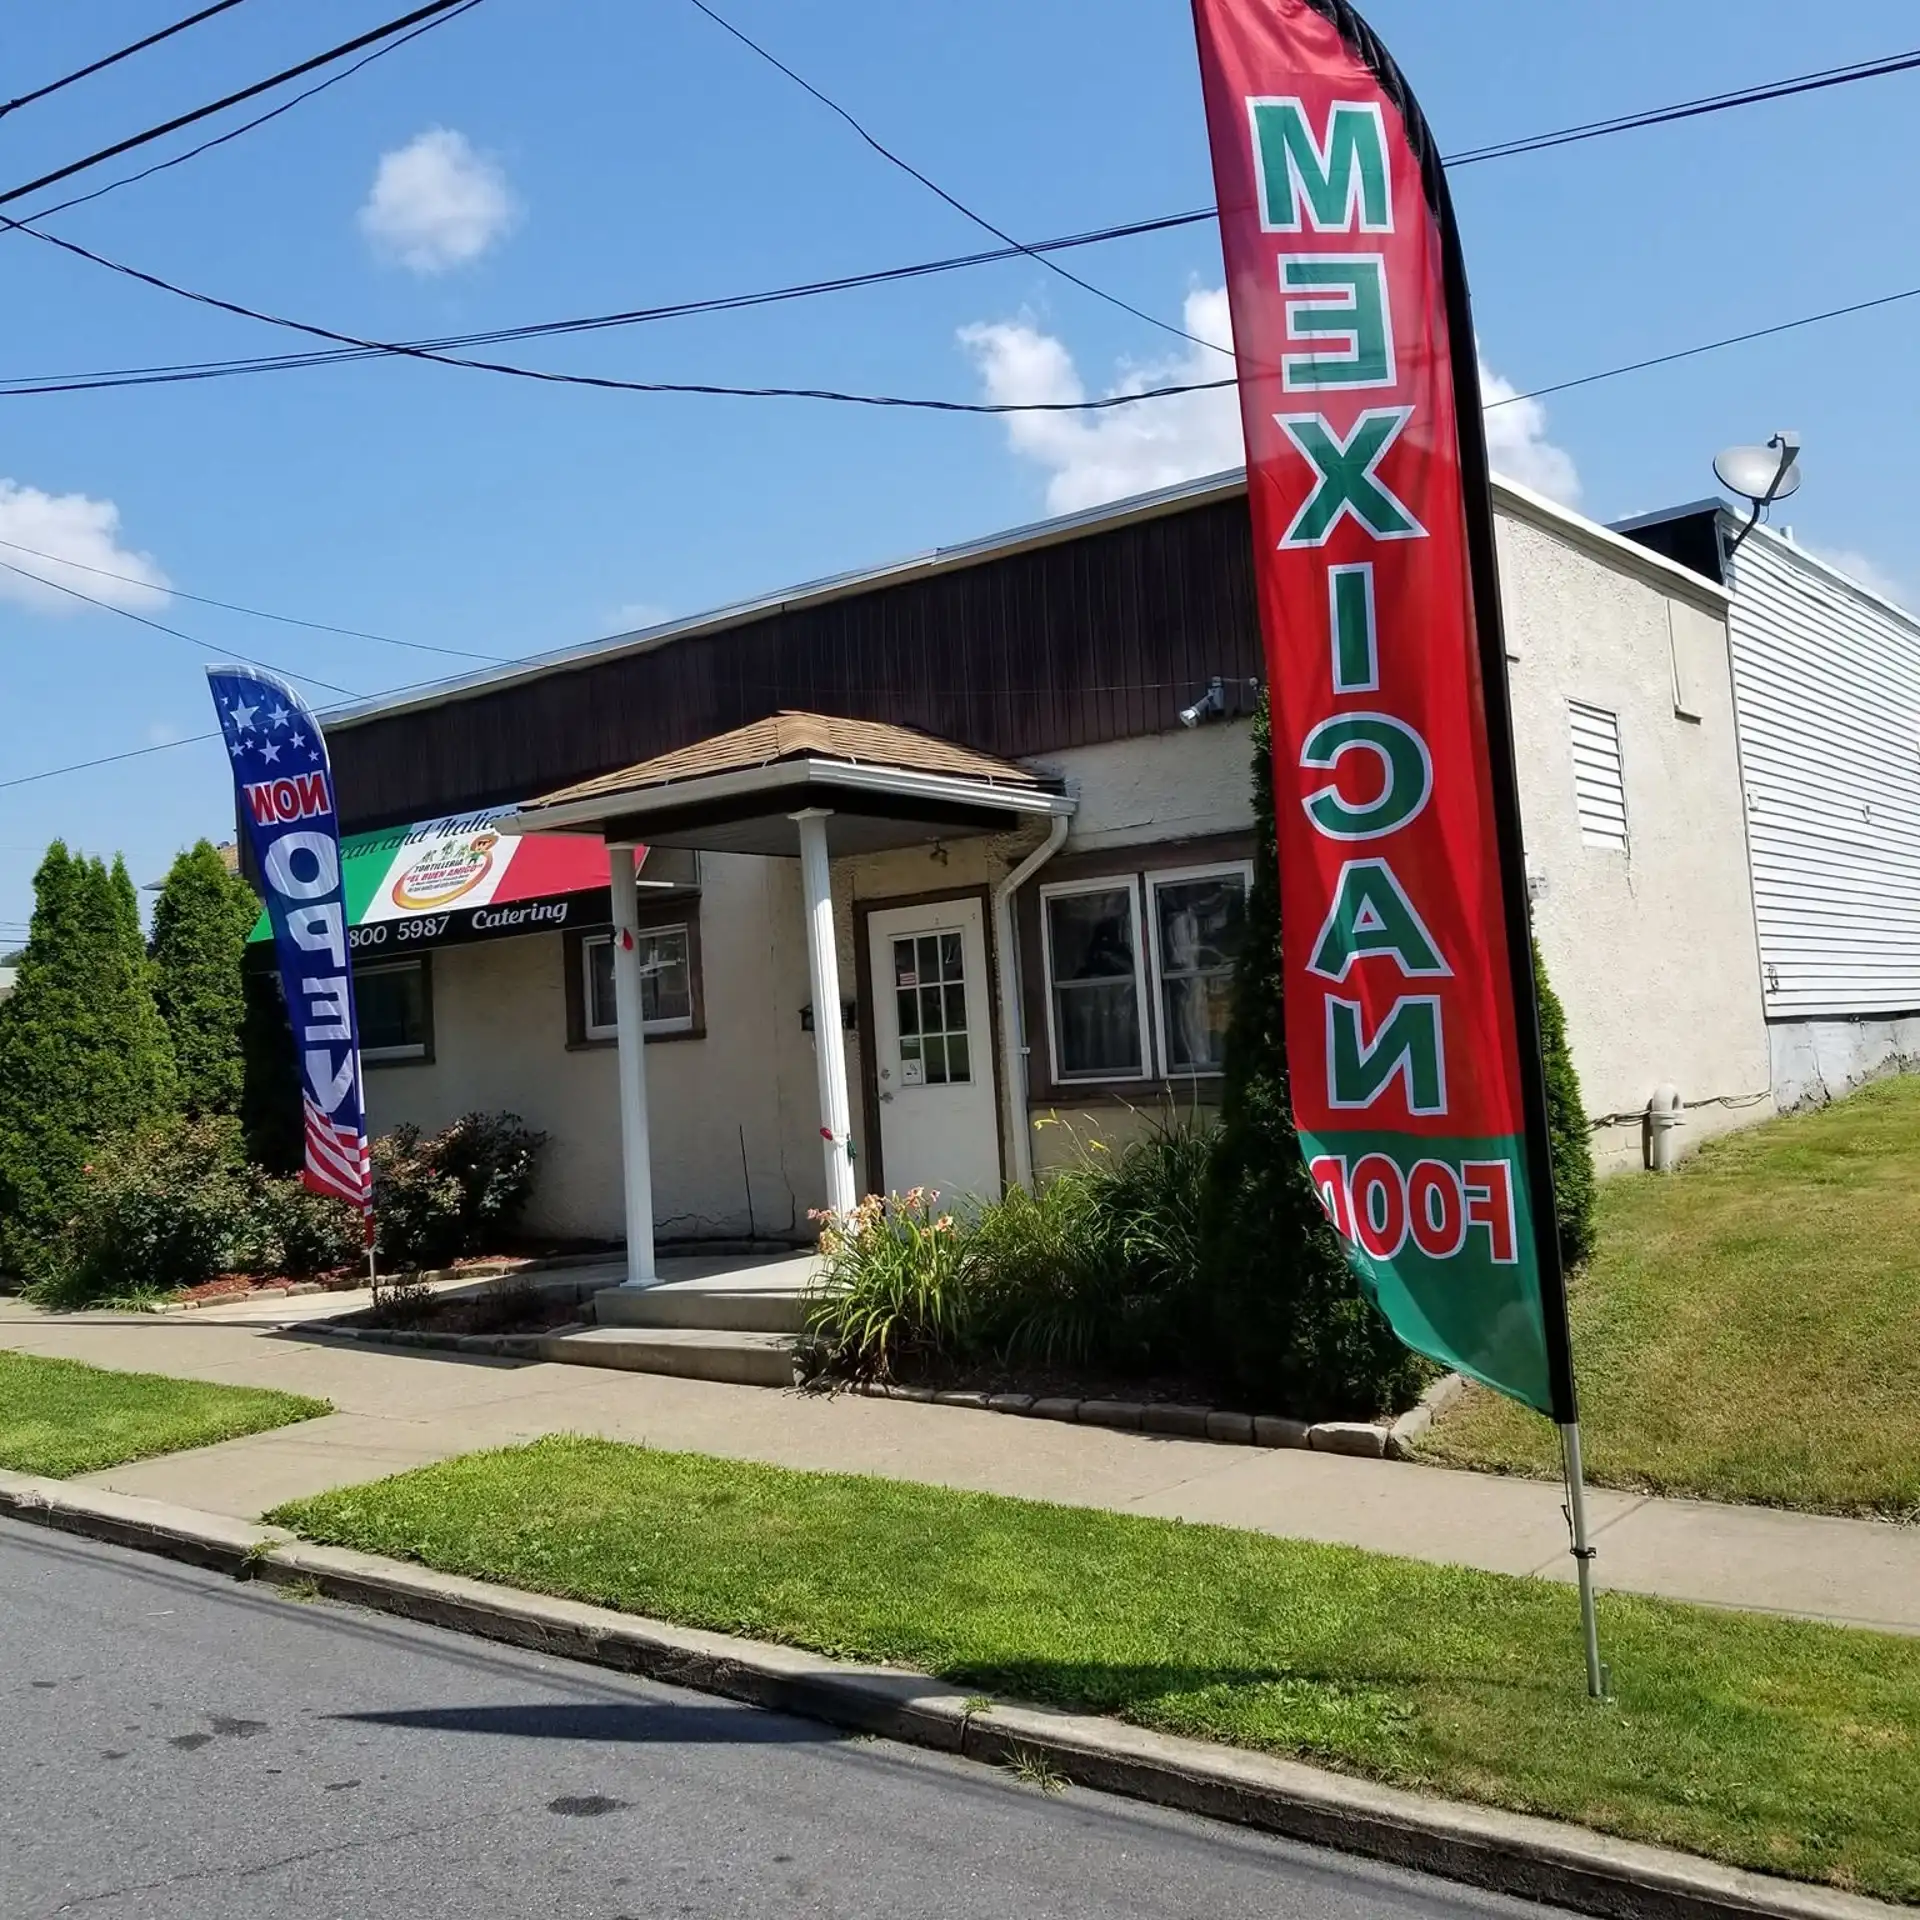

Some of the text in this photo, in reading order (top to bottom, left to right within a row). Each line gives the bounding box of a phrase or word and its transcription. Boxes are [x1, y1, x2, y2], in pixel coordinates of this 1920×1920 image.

[382, 824, 432, 850] and
[414, 859, 464, 873] TORTILLERIA
[349, 902, 568, 948] 800 5987 Catering
